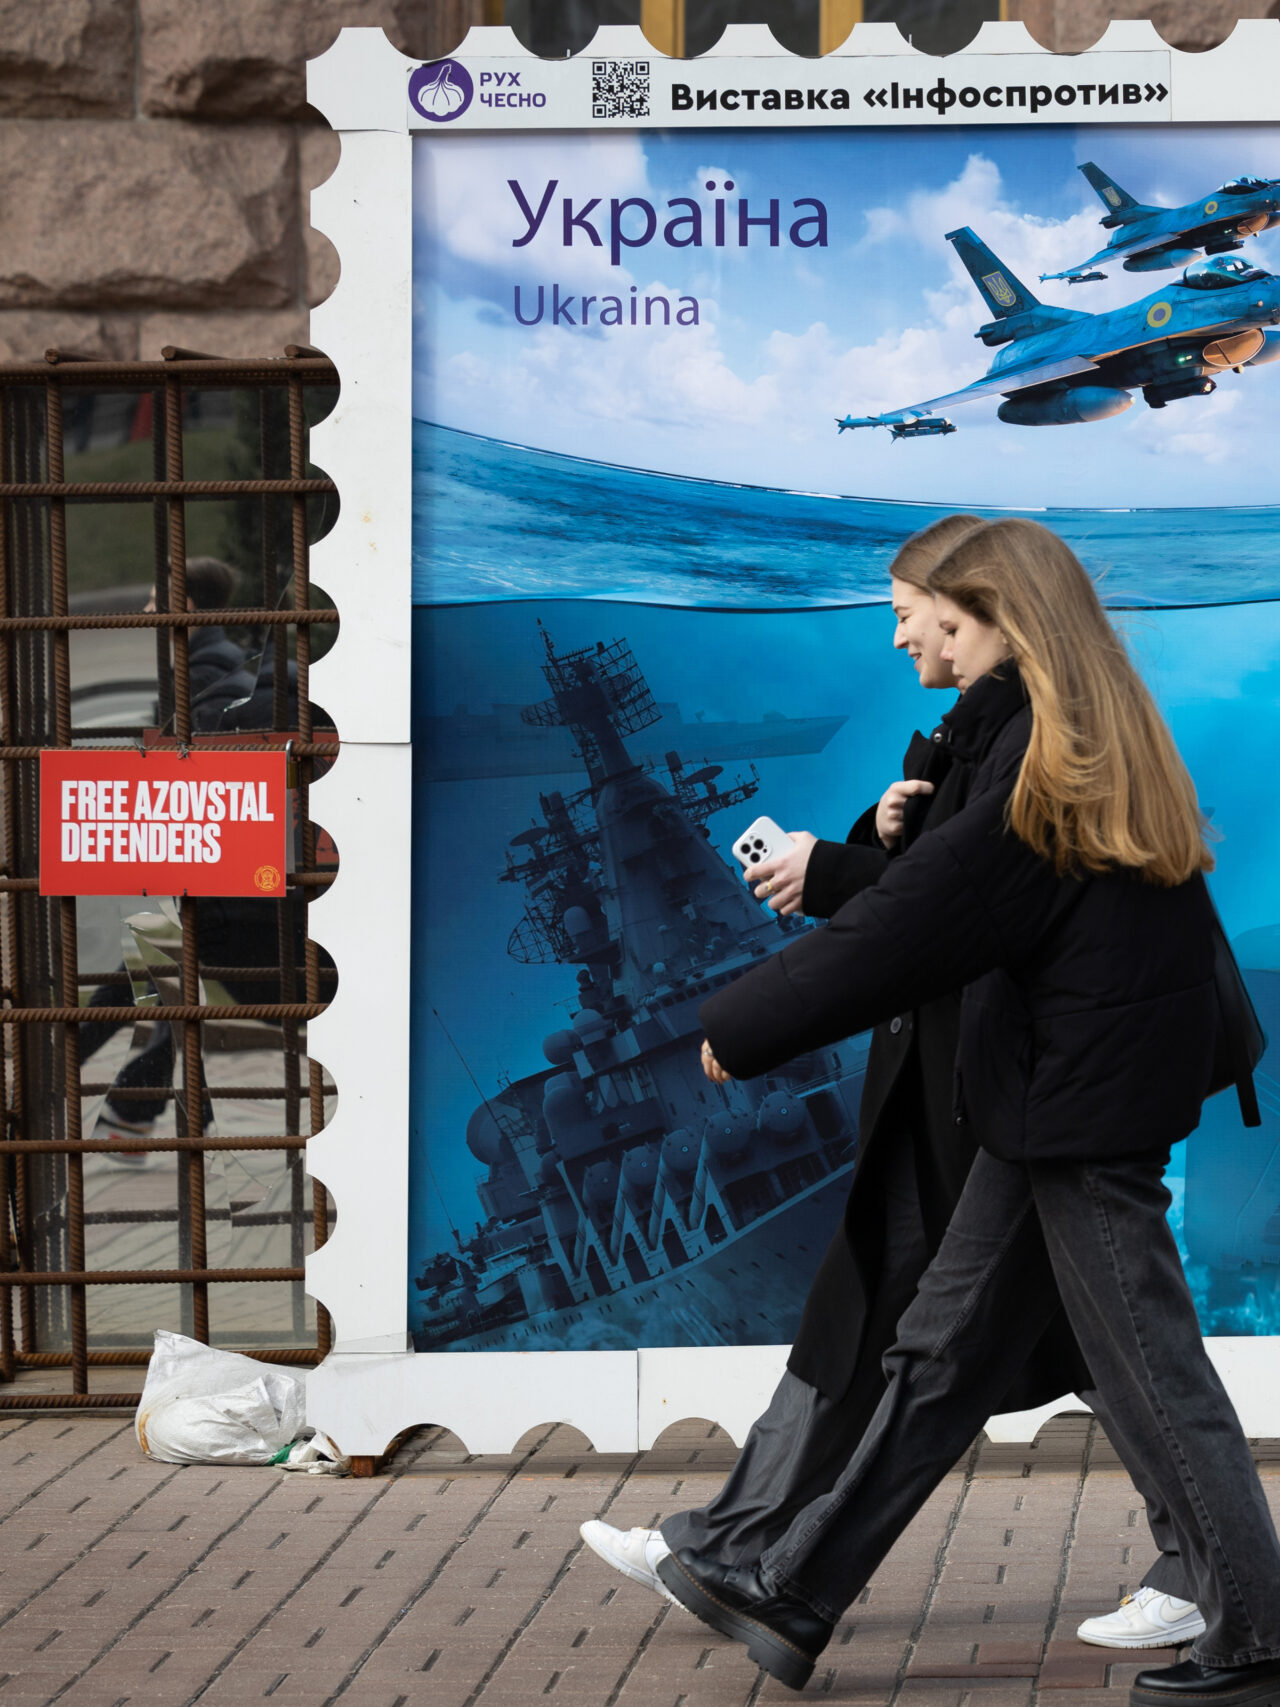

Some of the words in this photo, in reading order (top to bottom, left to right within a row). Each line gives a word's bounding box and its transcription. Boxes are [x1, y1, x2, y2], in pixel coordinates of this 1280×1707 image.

[479, 71, 521, 87] РУХ
[479, 92, 547, 108] ЧЕСНО
[671, 82, 850, 111] Виставка
[862, 77, 1170, 117] «Інфоспротив»
[507, 179, 829, 266] Україна
[513, 283, 700, 327] Ukraina
[61, 779, 130, 821] FREE
[133, 780, 275, 822] AZOVSTAL
[61, 822, 222, 864] DEFENDERS
